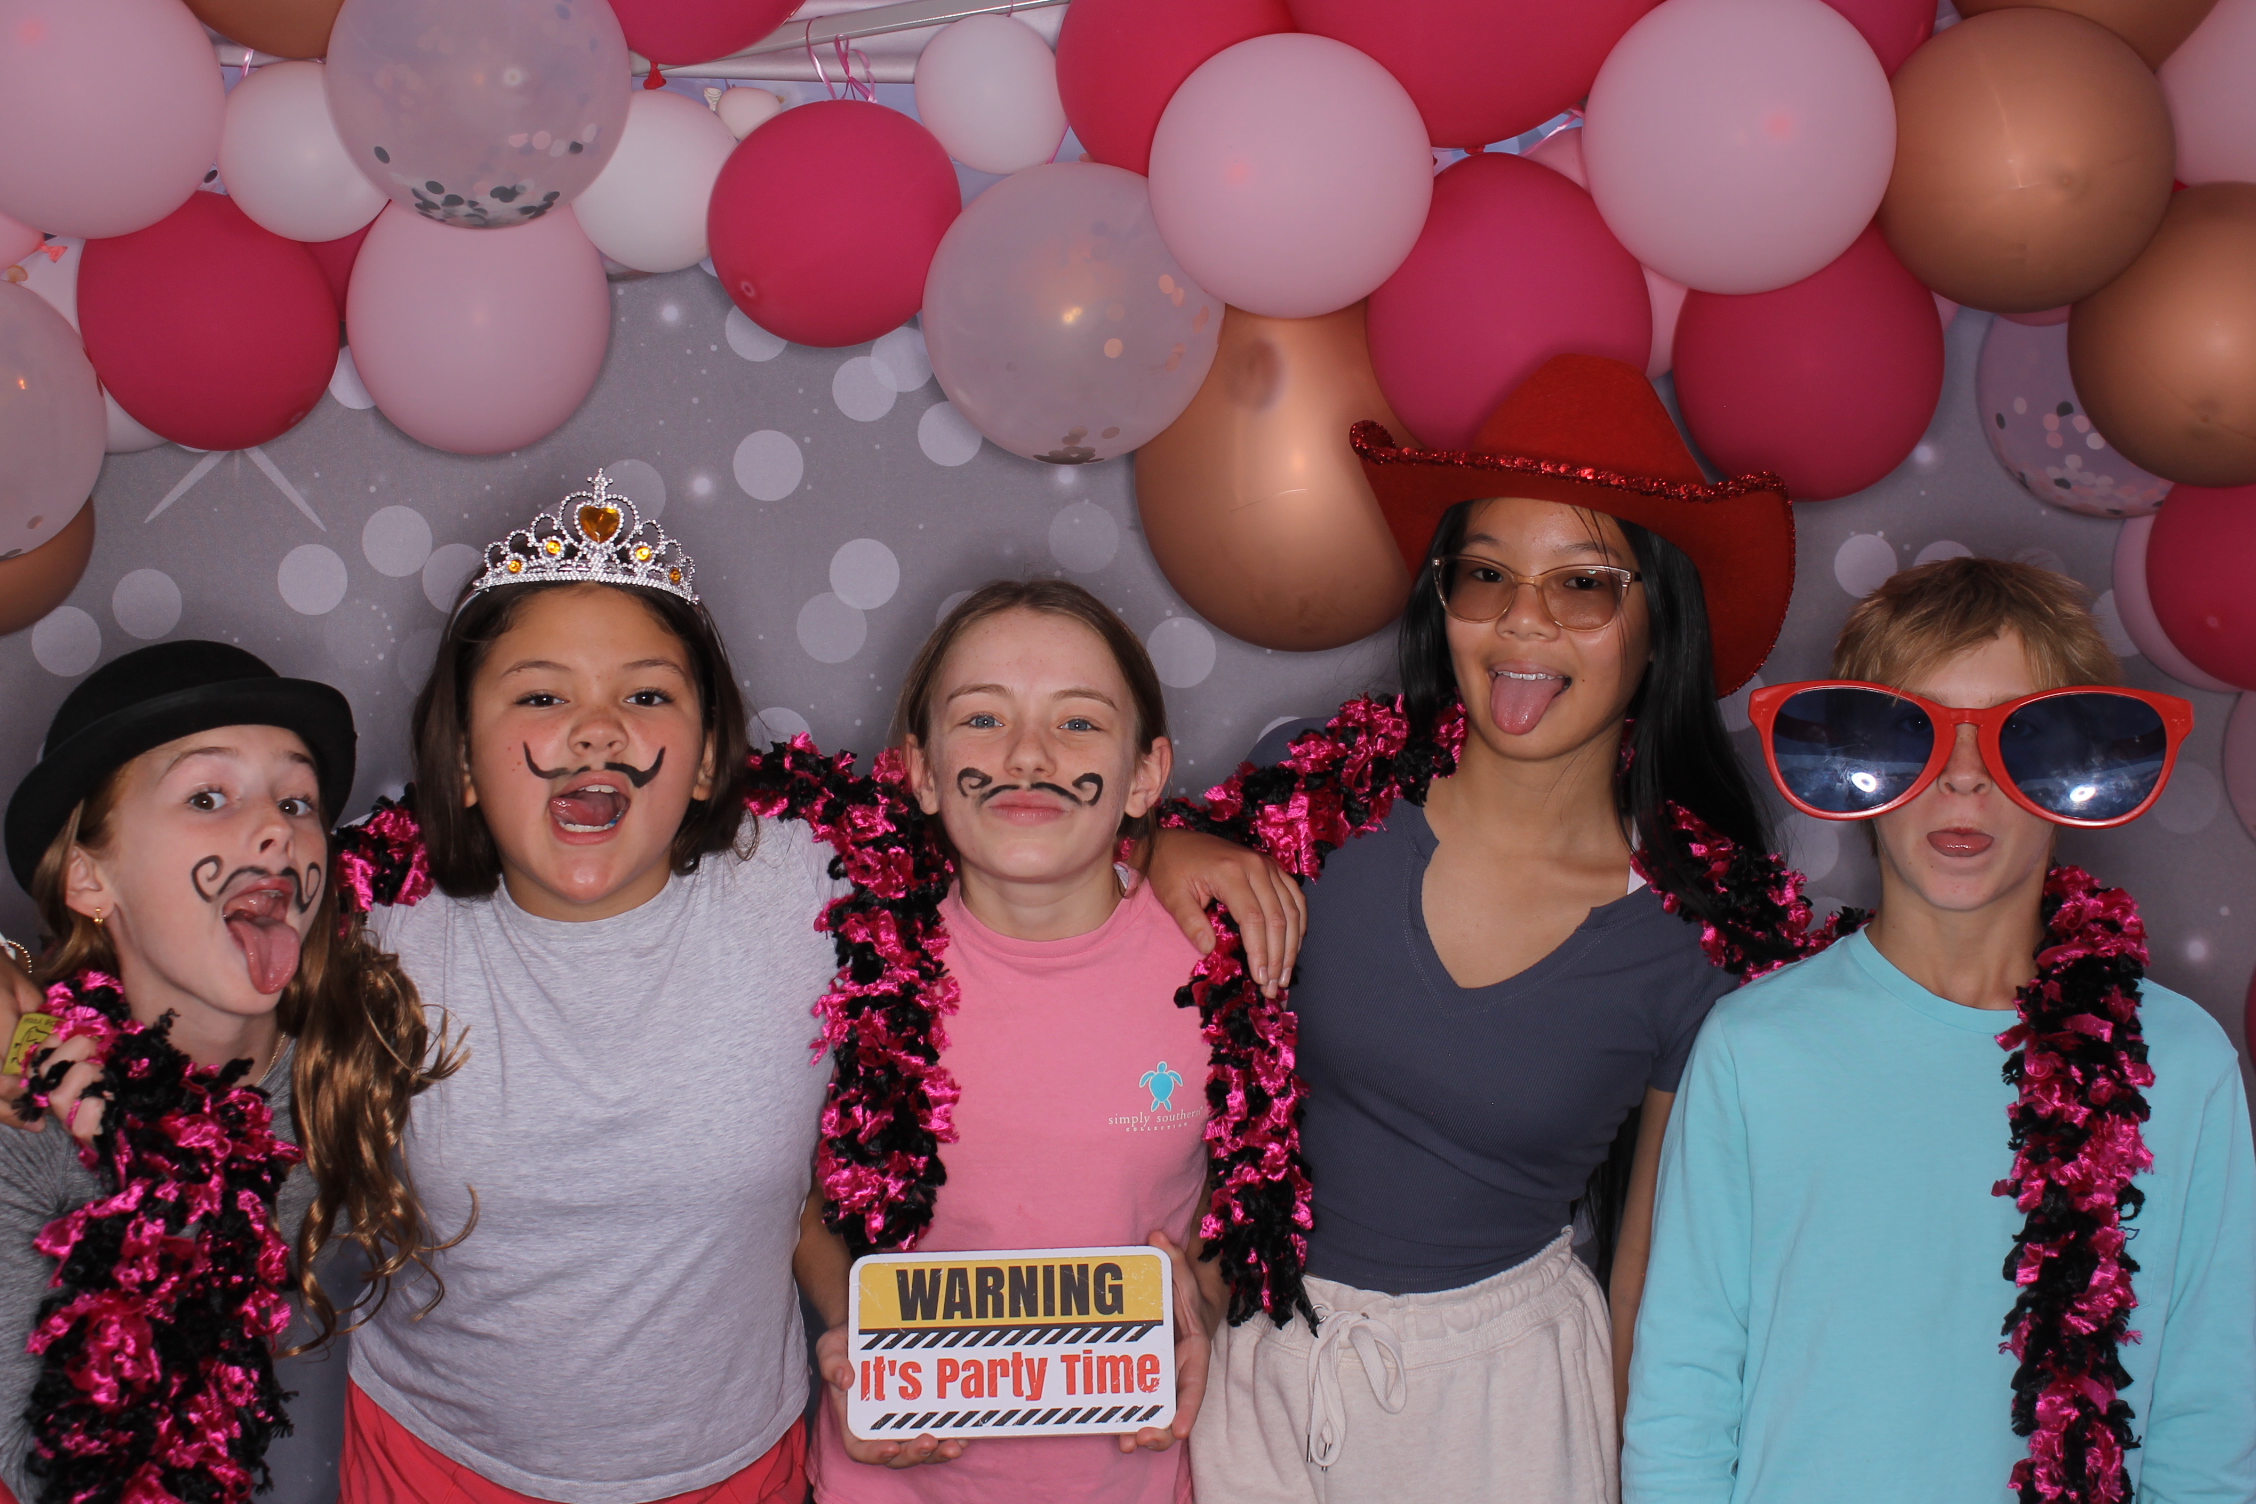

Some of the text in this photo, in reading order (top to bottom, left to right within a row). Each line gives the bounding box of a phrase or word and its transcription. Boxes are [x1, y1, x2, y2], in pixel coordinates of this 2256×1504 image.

[1108, 1108, 1201, 1127] simply southern
[896, 1262, 1124, 1321] WARNING
[860, 1349, 1160, 1401] It's Party Time
